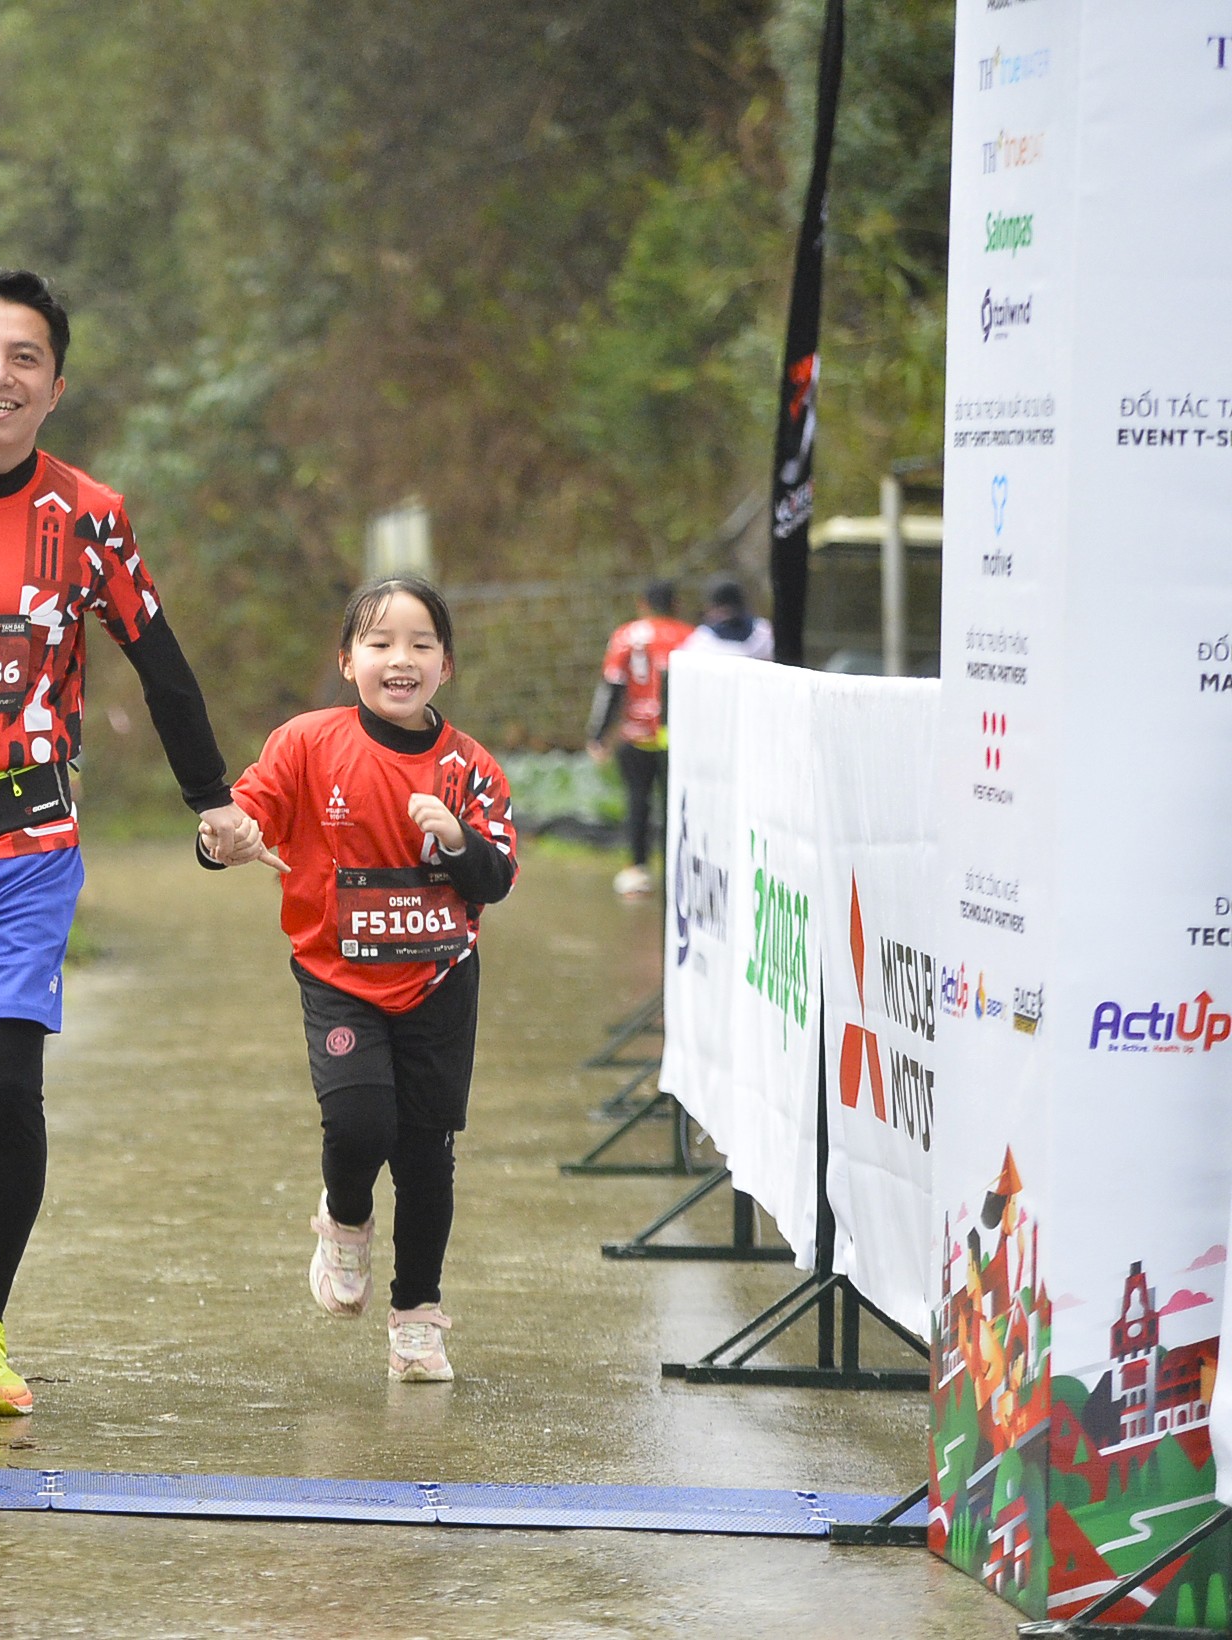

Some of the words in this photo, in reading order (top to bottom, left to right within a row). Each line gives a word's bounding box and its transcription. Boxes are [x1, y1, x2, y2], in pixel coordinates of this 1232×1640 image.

[1120, 389, 1159, 418] ĐỐI
[1166, 393, 1209, 418] TÁC
[1217, 398, 1232, 418] T
[1117, 428, 1189, 446] EVENT
[1193, 428, 1232, 447] T-S
[1197, 633, 1232, 662] ĐỐ
[389, 896, 421, 906] 05KM
[1214, 896, 1232, 915] Đ
[351, 907, 456, 934] F51061
[1187, 927, 1232, 947] TEC
[1089, 991, 1232, 1050] ActiUp
